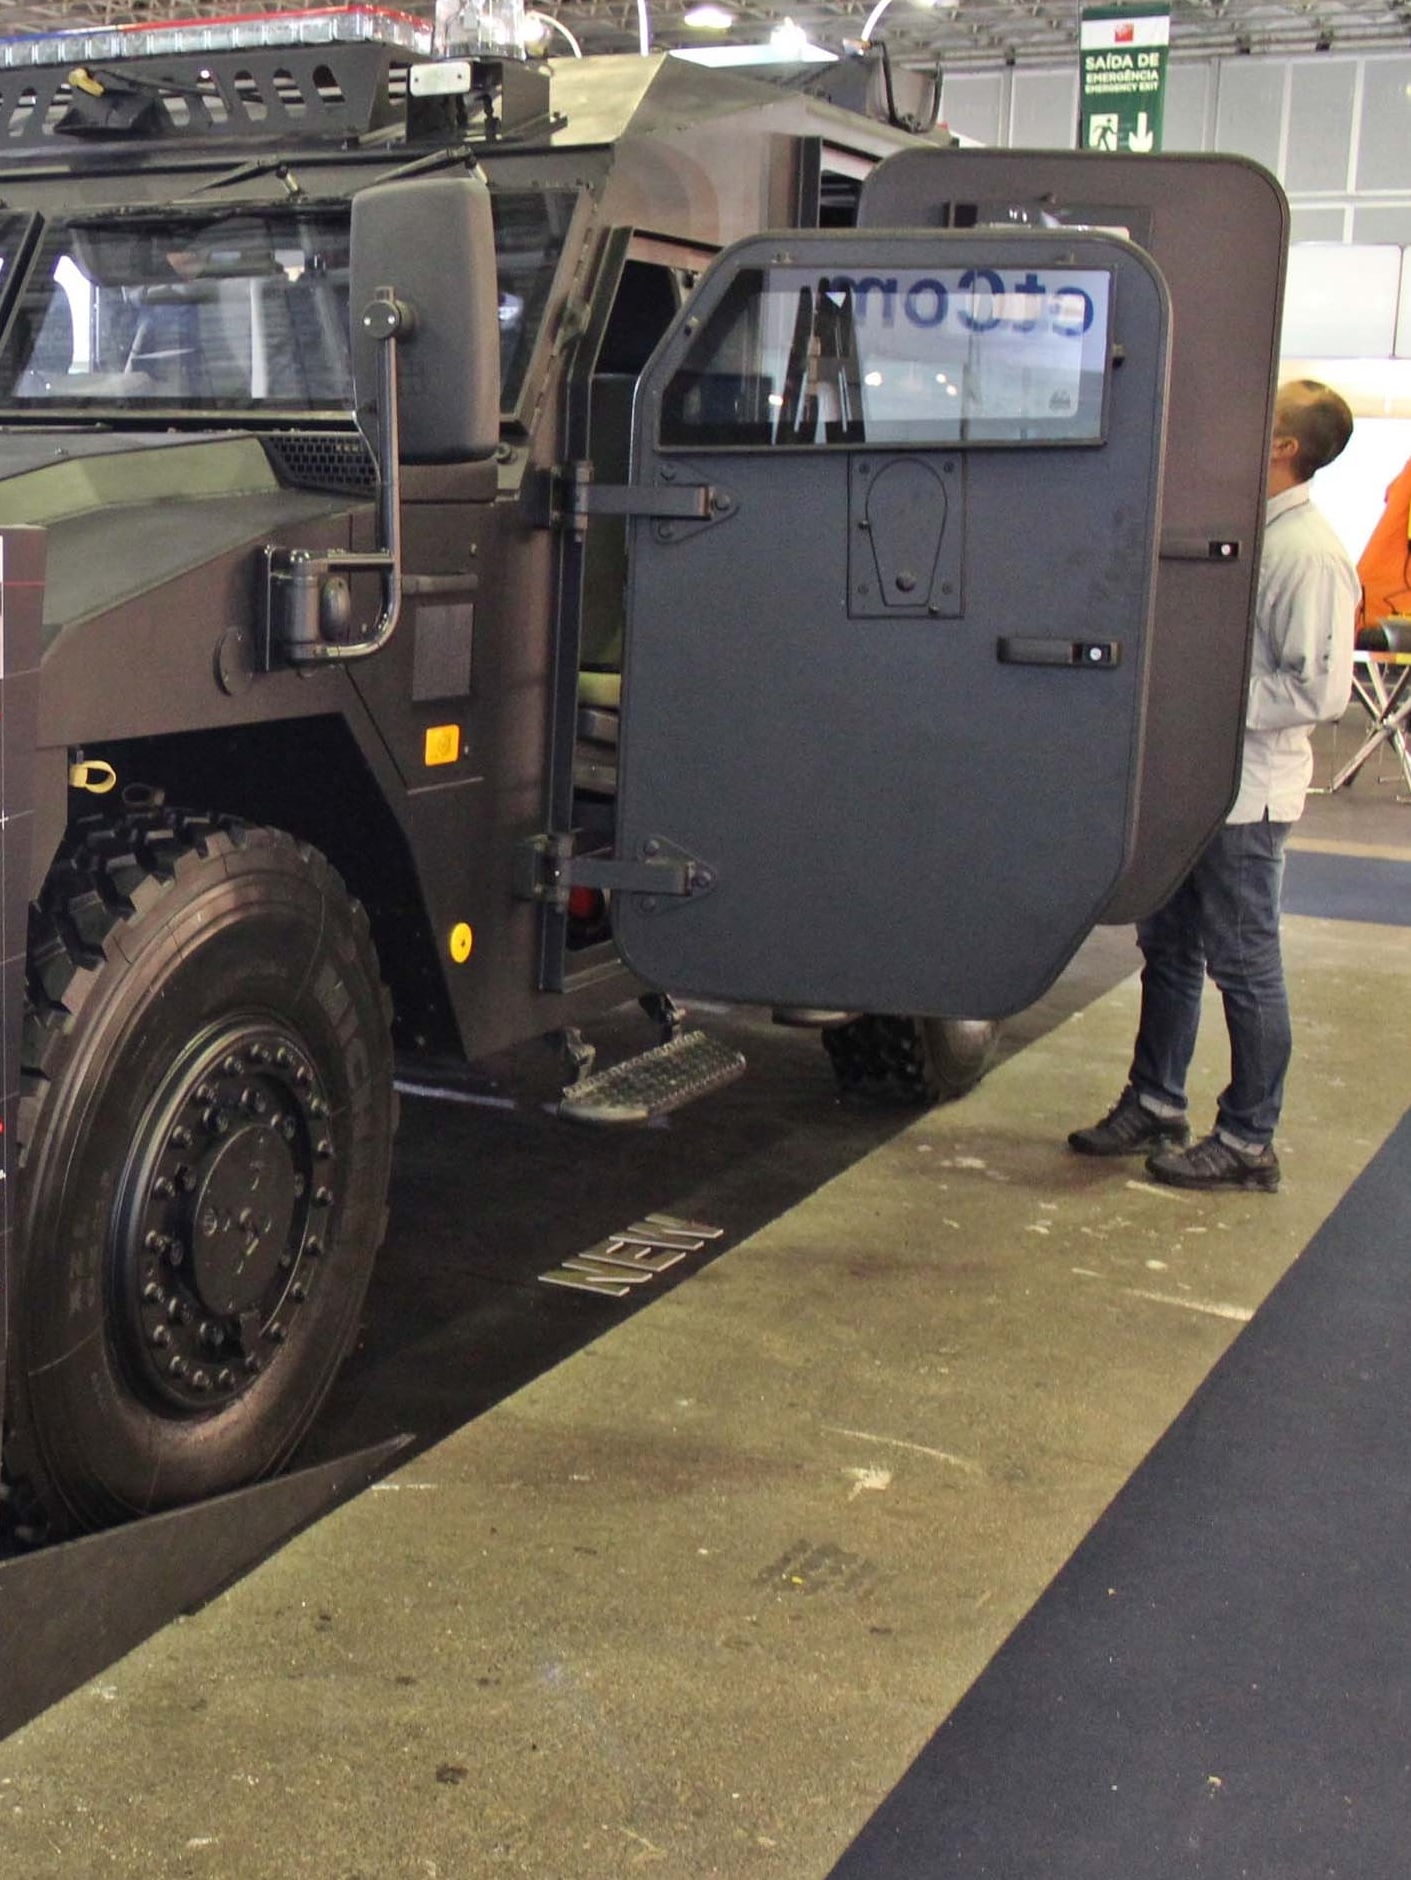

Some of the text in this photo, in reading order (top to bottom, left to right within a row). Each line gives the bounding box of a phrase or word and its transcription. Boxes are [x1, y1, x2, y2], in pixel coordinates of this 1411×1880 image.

[1085, 52, 1160, 71] SAÍDA DE
[1085, 69, 1159, 84] EMERGÊNCIA
[538, 1213, 724, 1297] NEW
